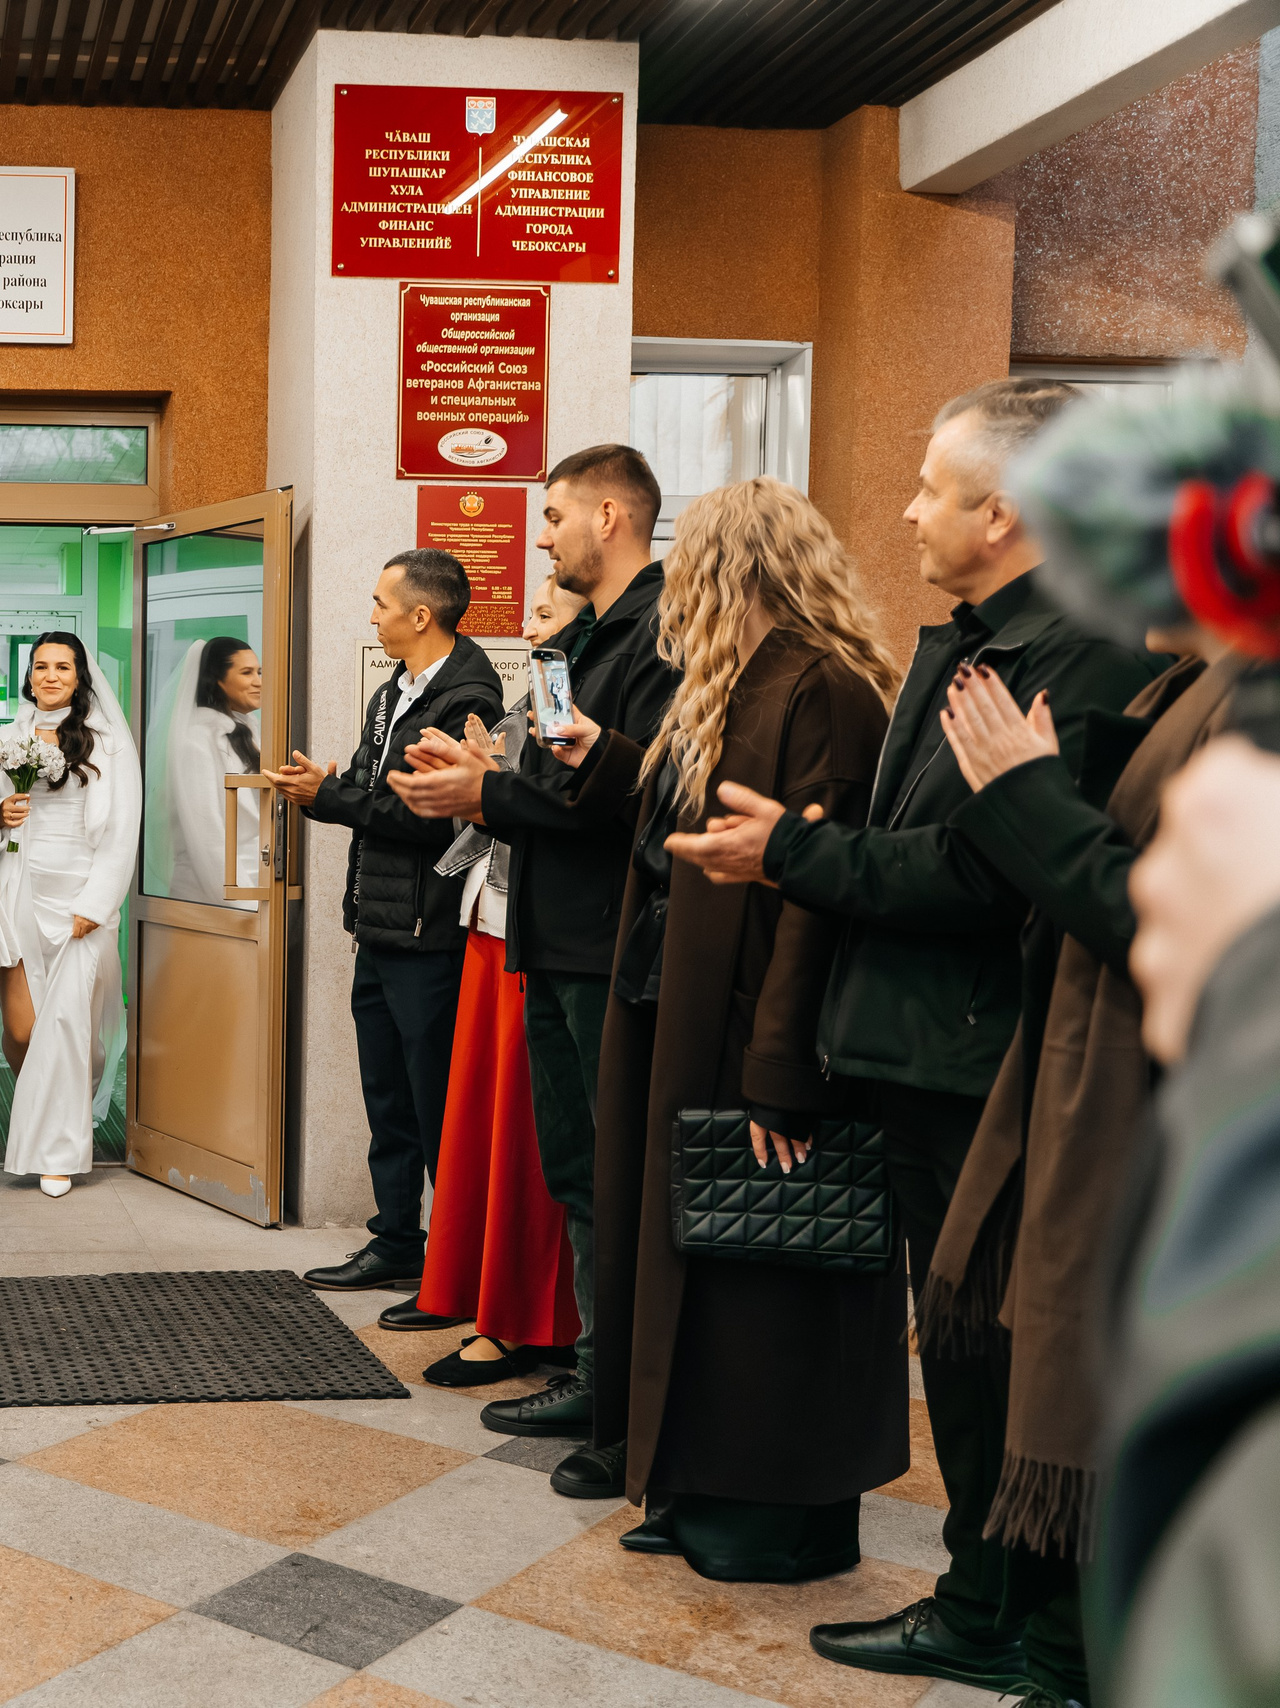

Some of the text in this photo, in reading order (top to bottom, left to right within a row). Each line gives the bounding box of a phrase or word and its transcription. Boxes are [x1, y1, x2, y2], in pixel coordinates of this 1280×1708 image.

[512, 134, 591, 148] ЧУАШСКАЯ
[364, 149, 450, 162] РЕСПУБЛИКИ
[511, 153, 593, 166] ЕСПУБЛИКА
[368, 167, 447, 179] ШУПАШКАР
[507, 171, 594, 184] ФИНАНСОВОЕ
[389, 184, 423, 197] ХУЛА
[510, 188, 591, 201] УПРАВЛЕНИЕ
[494, 206, 605, 220] АДМИНИСТРАЦИИ
[378, 220, 434, 232] ФИНАНС
[525, 222, 574, 236] ГОРОДА
[511, 240, 587, 253] ЧЕБОКСАРЫ
[2, 275, 48, 292] района
[420, 294, 531, 309] Чувашская республиканская
[450, 311, 500, 323] организация
[441, 328, 516, 341] Общероссийской
[416, 343, 536, 357] общественной организации
[420, 361, 528, 375] «Российский Союз
[406, 378, 542, 392] ветеранов Афганистана
[430, 396, 517, 407] и специальных
[416, 411, 530, 426] военных операций»
[373, 711, 387, 746] CALVIN
